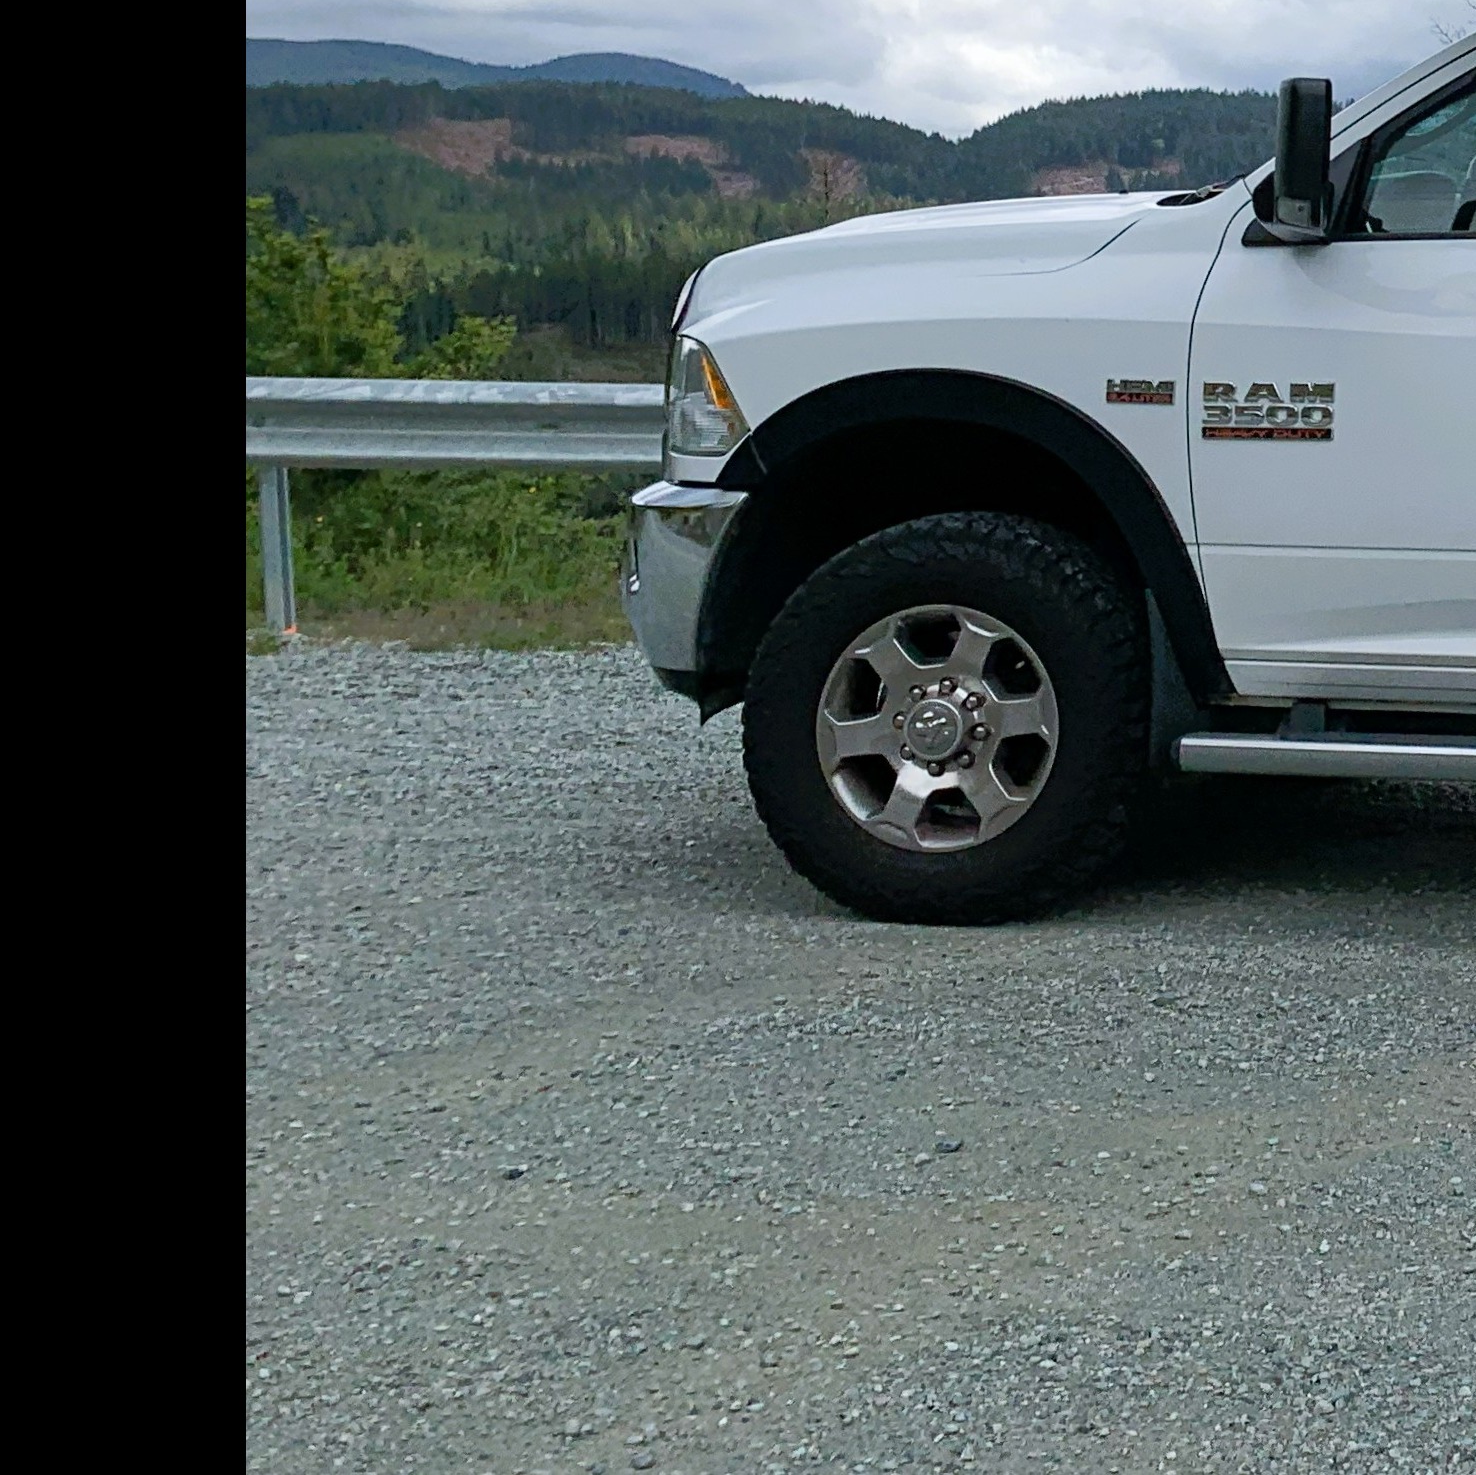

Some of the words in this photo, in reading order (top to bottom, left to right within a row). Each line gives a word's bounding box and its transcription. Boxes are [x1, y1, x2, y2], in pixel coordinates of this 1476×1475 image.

[1203, 381, 1335, 404] RAM
[1202, 404, 1334, 427] 3500
[1205, 428, 1270, 438] HEAVY
[1272, 429, 1326, 439] DUTY
